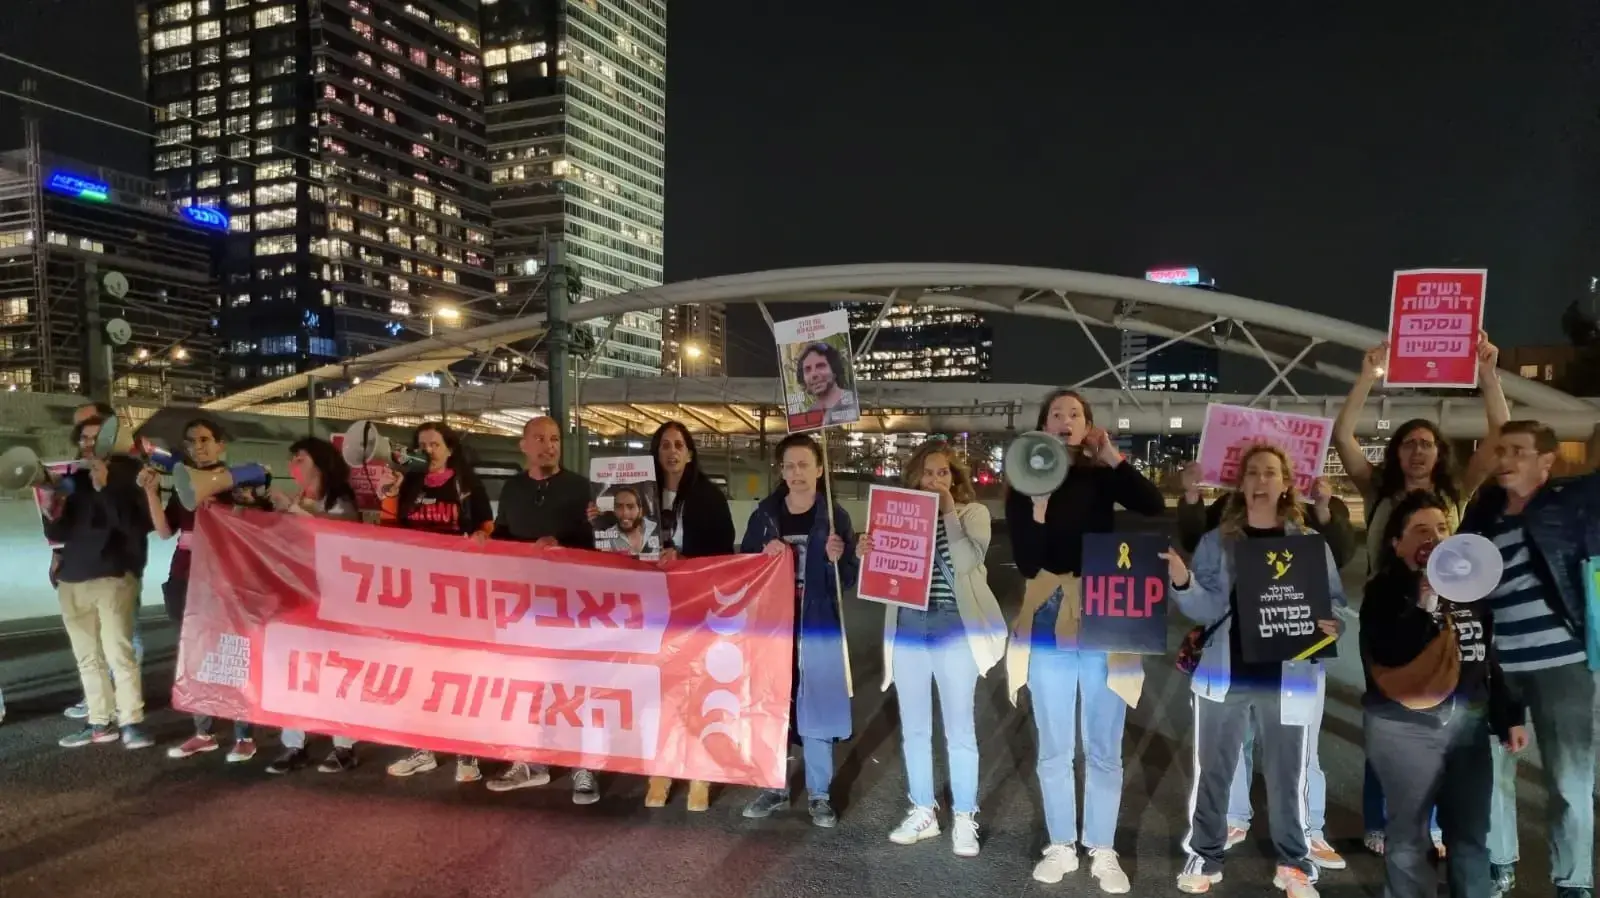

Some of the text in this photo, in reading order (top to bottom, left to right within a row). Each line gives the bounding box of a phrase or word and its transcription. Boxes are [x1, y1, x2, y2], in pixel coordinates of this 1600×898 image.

[1416, 282, 1461, 295] נשים
[1402, 296, 1474, 310] דורשות
[1410, 318, 1462, 331] עסקה
[1406, 340, 1462, 353] עכשיו!
[886, 500, 920, 517] נשים
[875, 512, 929, 533] דורשות
[880, 535, 919, 551] עסקה
[875, 555, 918, 573] עכשיו!
[340, 555, 645, 630] נאבקות על
[1085, 575, 1164, 618] HELP
[1259, 605, 1311, 626] כפדיון
[1259, 621, 1315, 638] שבויים
[288, 649, 633, 731] האחיות שלנו
